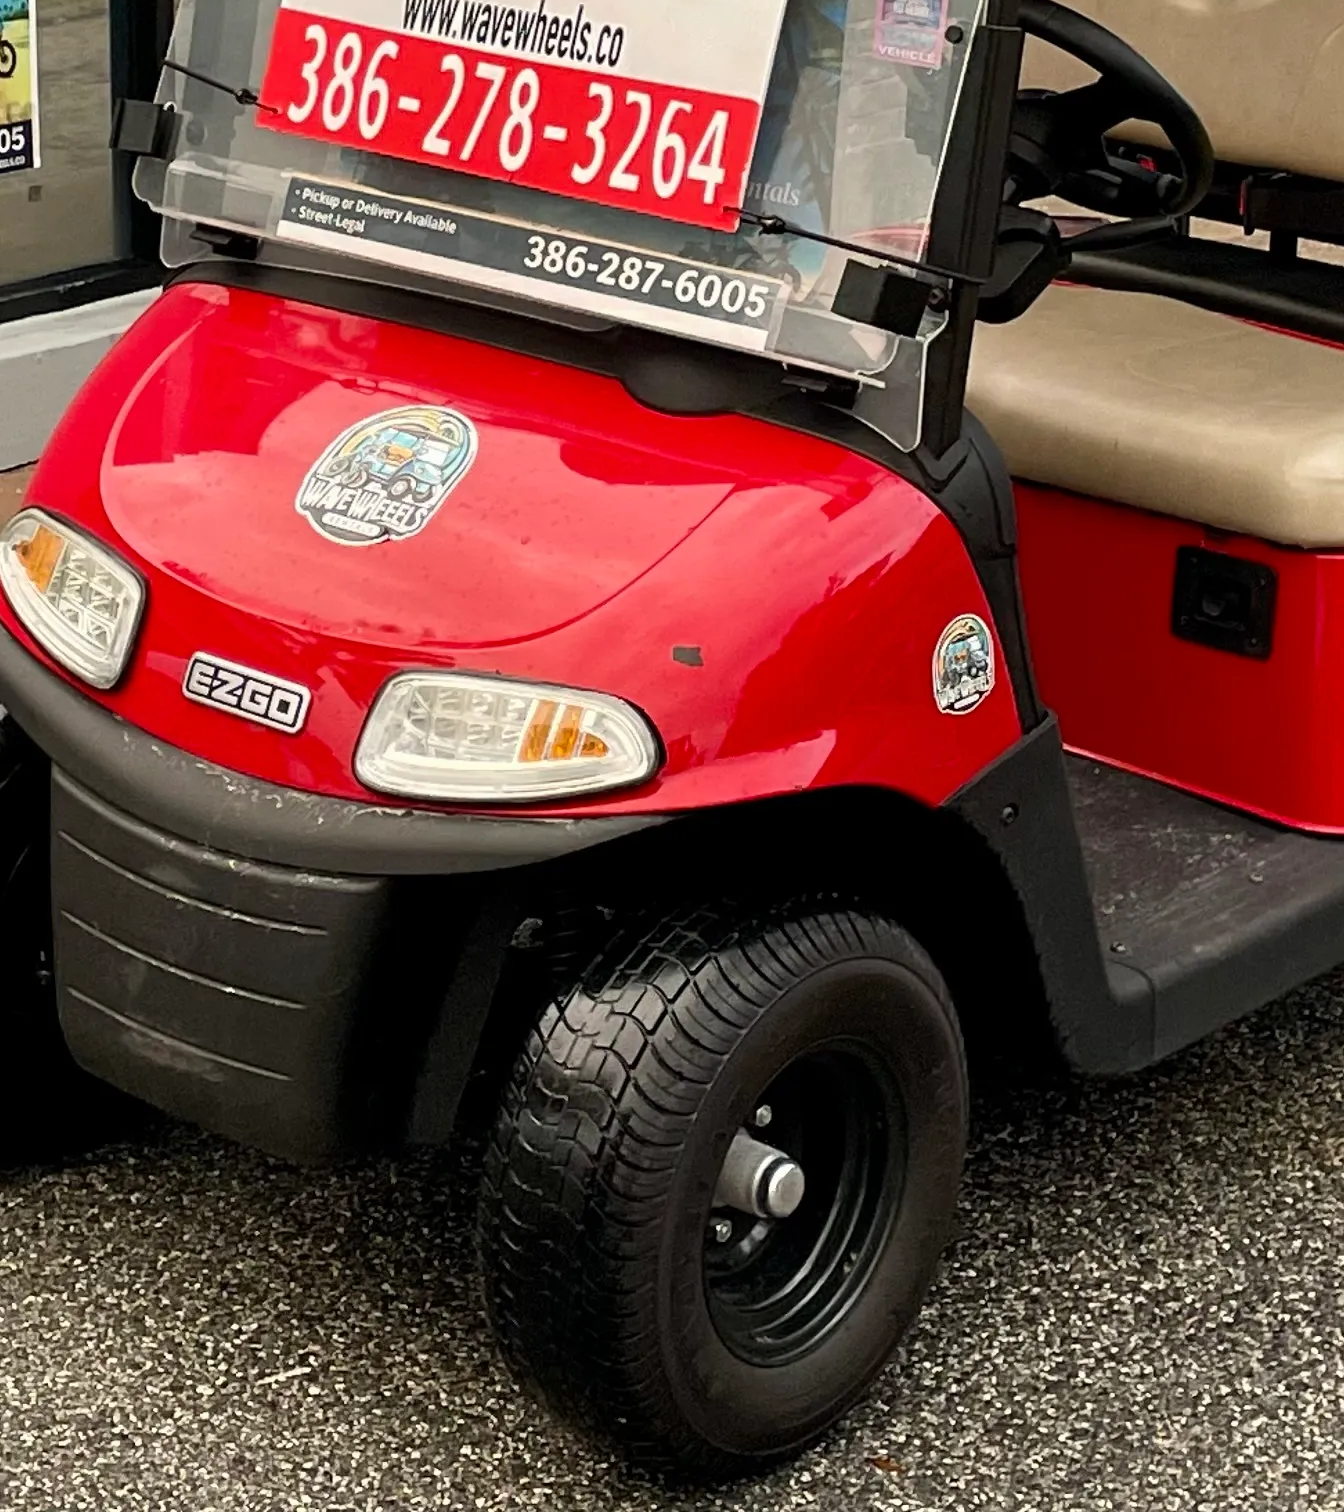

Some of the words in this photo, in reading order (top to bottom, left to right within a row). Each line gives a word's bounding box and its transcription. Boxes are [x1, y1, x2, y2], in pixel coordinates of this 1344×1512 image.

[878, 44, 936, 64] VEHICLE
[287, 24, 731, 205] 386-278-3264
[302, 187, 341, 209] Pickup
[341, 197, 355, 209] or
[356, 199, 405, 225] Delivery
[404, 210, 457, 235] Available
[747, 182, 801, 206] ntals
[523, 235, 770, 318] 386-287-6005
[301, 477, 353, 511] WAVE
[187, 661, 301, 726] EZGO
